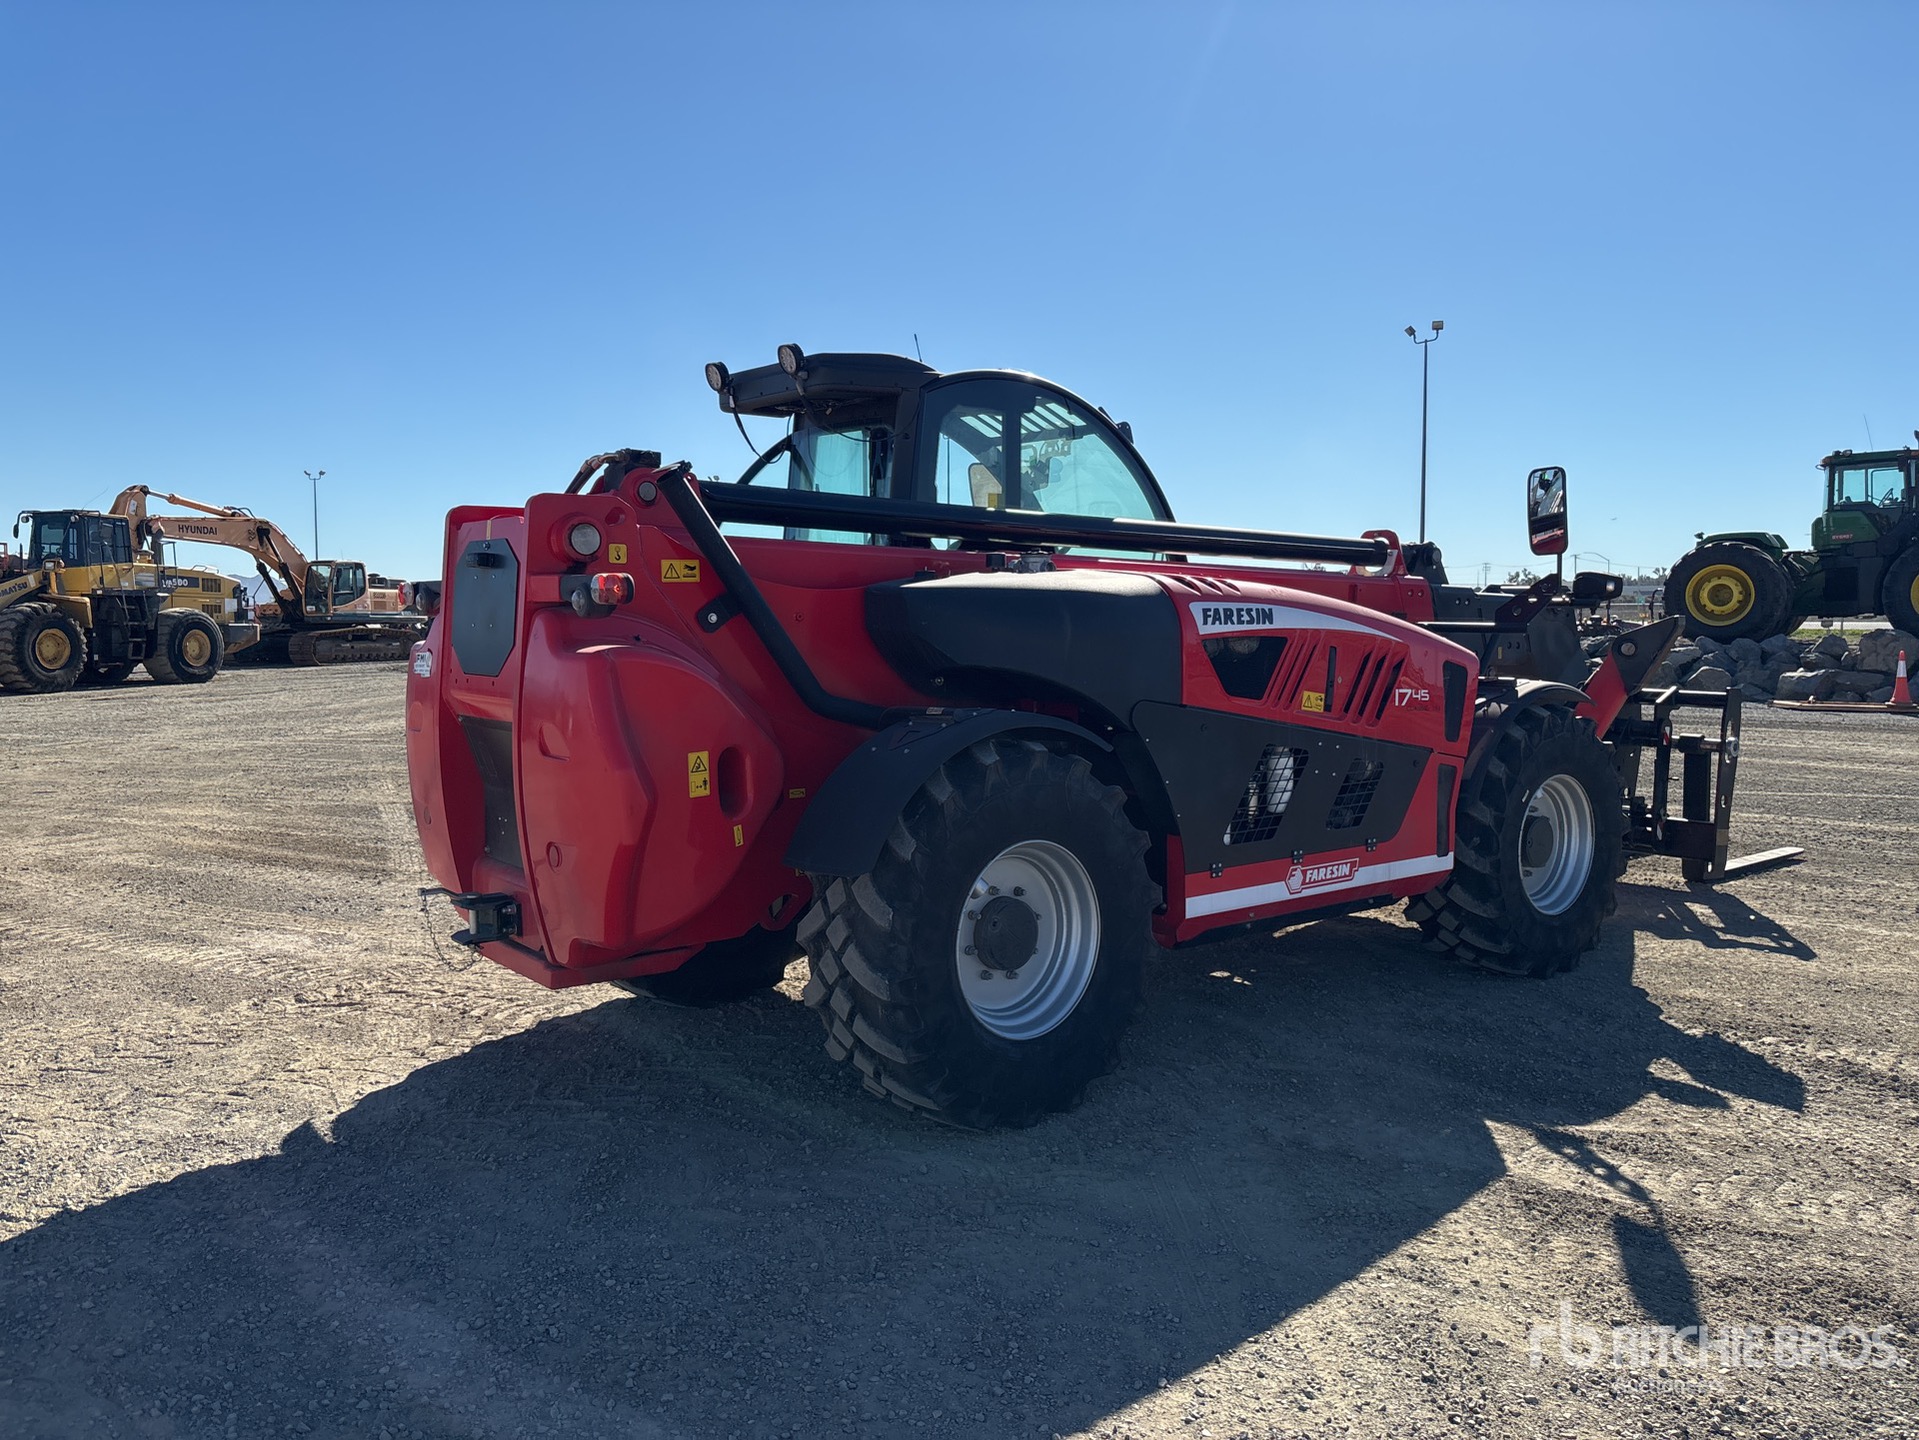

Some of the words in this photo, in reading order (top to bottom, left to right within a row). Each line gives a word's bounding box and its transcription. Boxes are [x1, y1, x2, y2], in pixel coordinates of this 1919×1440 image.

[178, 524, 218, 535] HYUNDAI
[0, 581, 28, 597] MATSU
[1201, 607, 1274, 626] FARESIN
[1394, 688, 1430, 707] 1745
[1305, 863, 1351, 883] FARESIN
